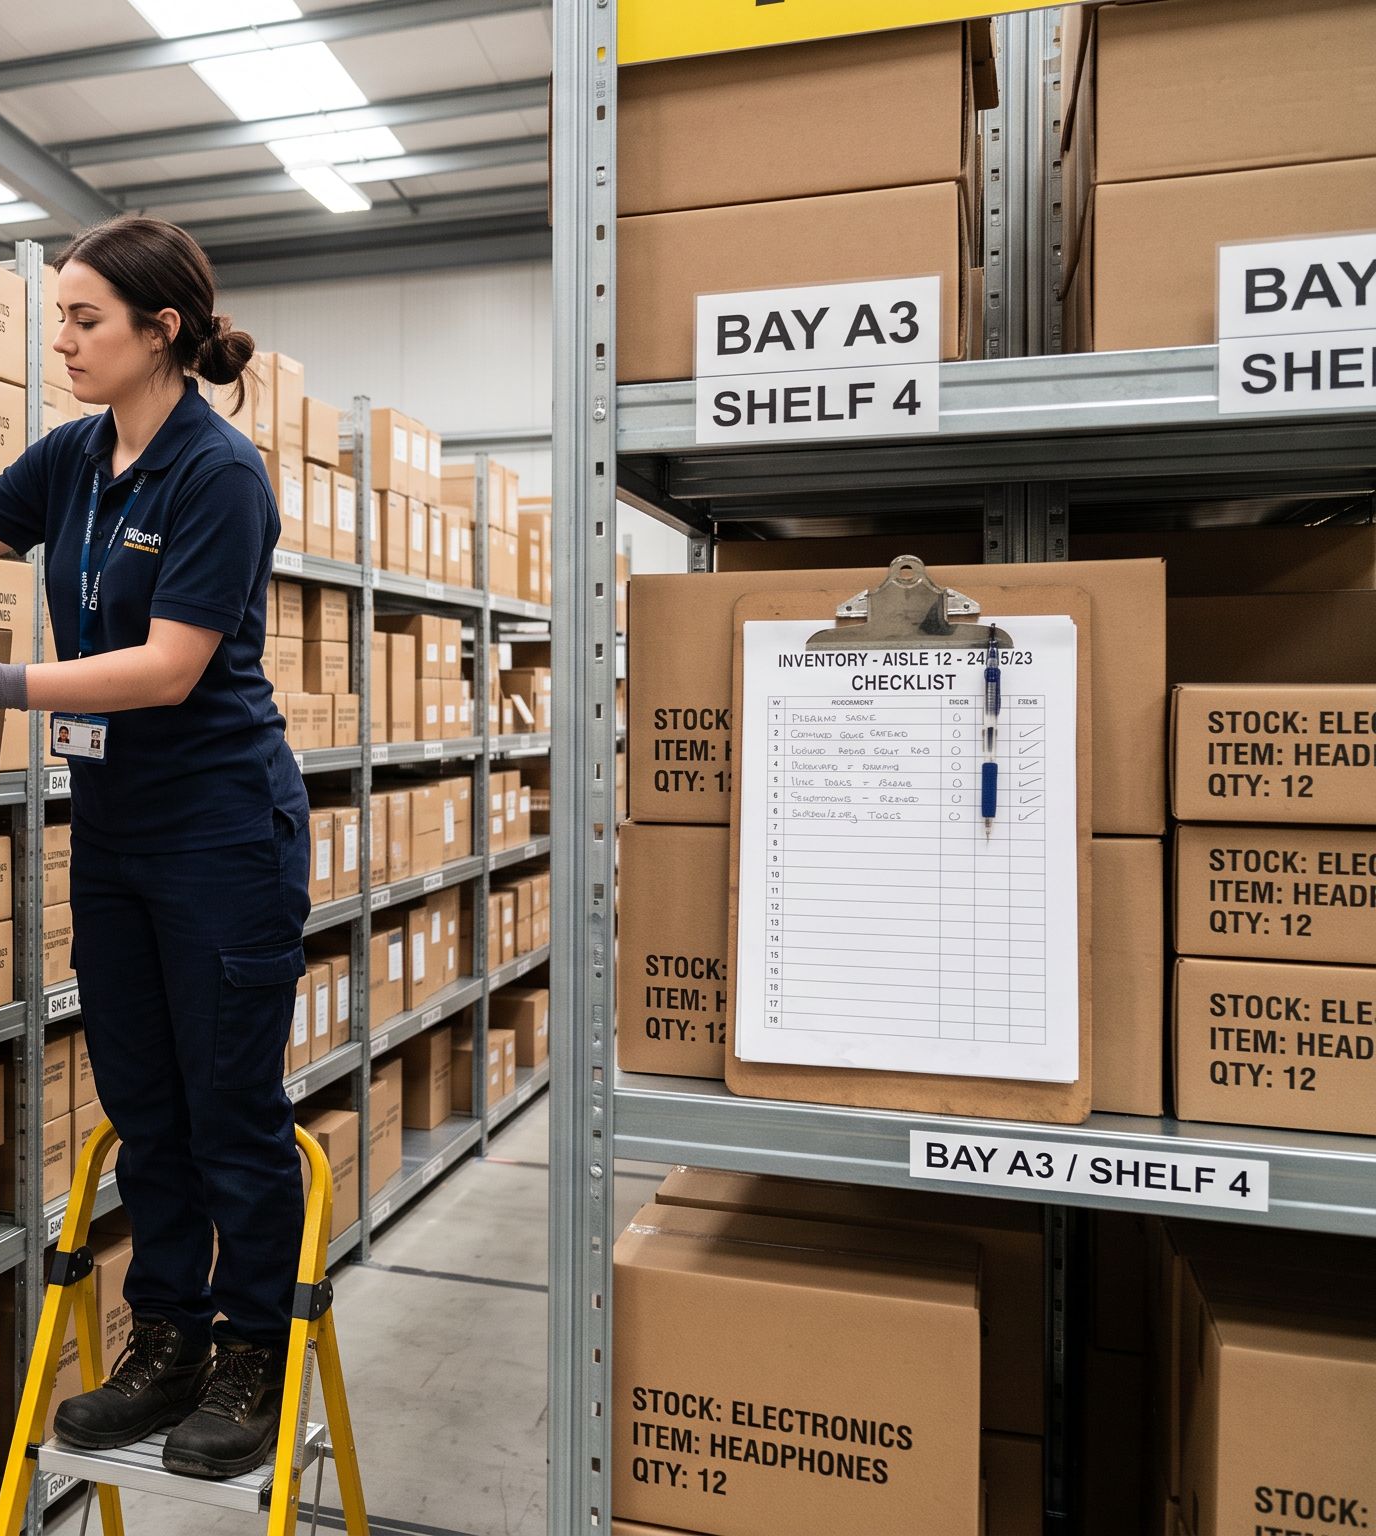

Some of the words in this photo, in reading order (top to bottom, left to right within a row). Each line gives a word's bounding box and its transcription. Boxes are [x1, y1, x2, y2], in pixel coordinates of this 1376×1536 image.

[1245, 259, 1376, 315] BAY
[716, 306, 830, 356] BAY
[843, 300, 919, 347] A3
[1241, 346, 1376, 394] SHE
[712, 382, 875, 427] SHELF
[892, 379, 921, 416] 4
[778, 652, 867, 668] INVENTORY
[882, 652, 929, 667] AISLE
[934, 652, 951, 666] 12
[967, 651, 1033, 666] 24/5/23
[851, 674, 956, 691] CHECKLIST
[654, 708, 730, 731] STOCK
[1208, 711, 1308, 734] STOCK:
[654, 739, 716, 761] ITEM:
[1208, 742, 1283, 766] ITEM:
[1294, 743, 1376, 767] HEAD
[52, 775, 68, 790] BAY
[654, 769, 705, 793] QTY:
[1208, 773, 1270, 798] QTY:
[1281, 775, 1314, 798] 12
[1209, 849, 1307, 874] STOCK:
[1209, 879, 1282, 904] ITEM:
[1293, 883, 1376, 908] HEAD
[1209, 909, 1270, 935] QTY:
[1280, 913, 1312, 936] 12
[646, 954, 727, 981] STOCK:
[646, 986, 707, 1012] ITEM:
[1210, 993, 1310, 1022] STOCK:
[1321, 999, 1376, 1026] ELE
[646, 1016, 696, 1042] QTY:
[1210, 1027, 1286, 1055] ITEM:
[1297, 1032, 1374, 1060] HEAD
[1210, 1060, 1272, 1088] QTY:
[1283, 1066, 1316, 1091] 12
[925, 1142, 998, 1173] BAY
[1006, 1150, 1054, 1179] A3
[1066, 1154, 1078, 1182] /
[1089, 1157, 1216, 1193] SHELF
[1228, 1171, 1250, 1197] 4
[632, 1386, 721, 1422] STOCK:
[731, 1400, 912, 1451] ELECTRONICS
[632, 1421, 700, 1455] ITEM:
[710, 1433, 888, 1485] HEADPHONES
[632, 1456, 688, 1489] QTY:
[697, 1468, 727, 1496] 12
[1254, 1486, 1368, 1528] STOCK:
